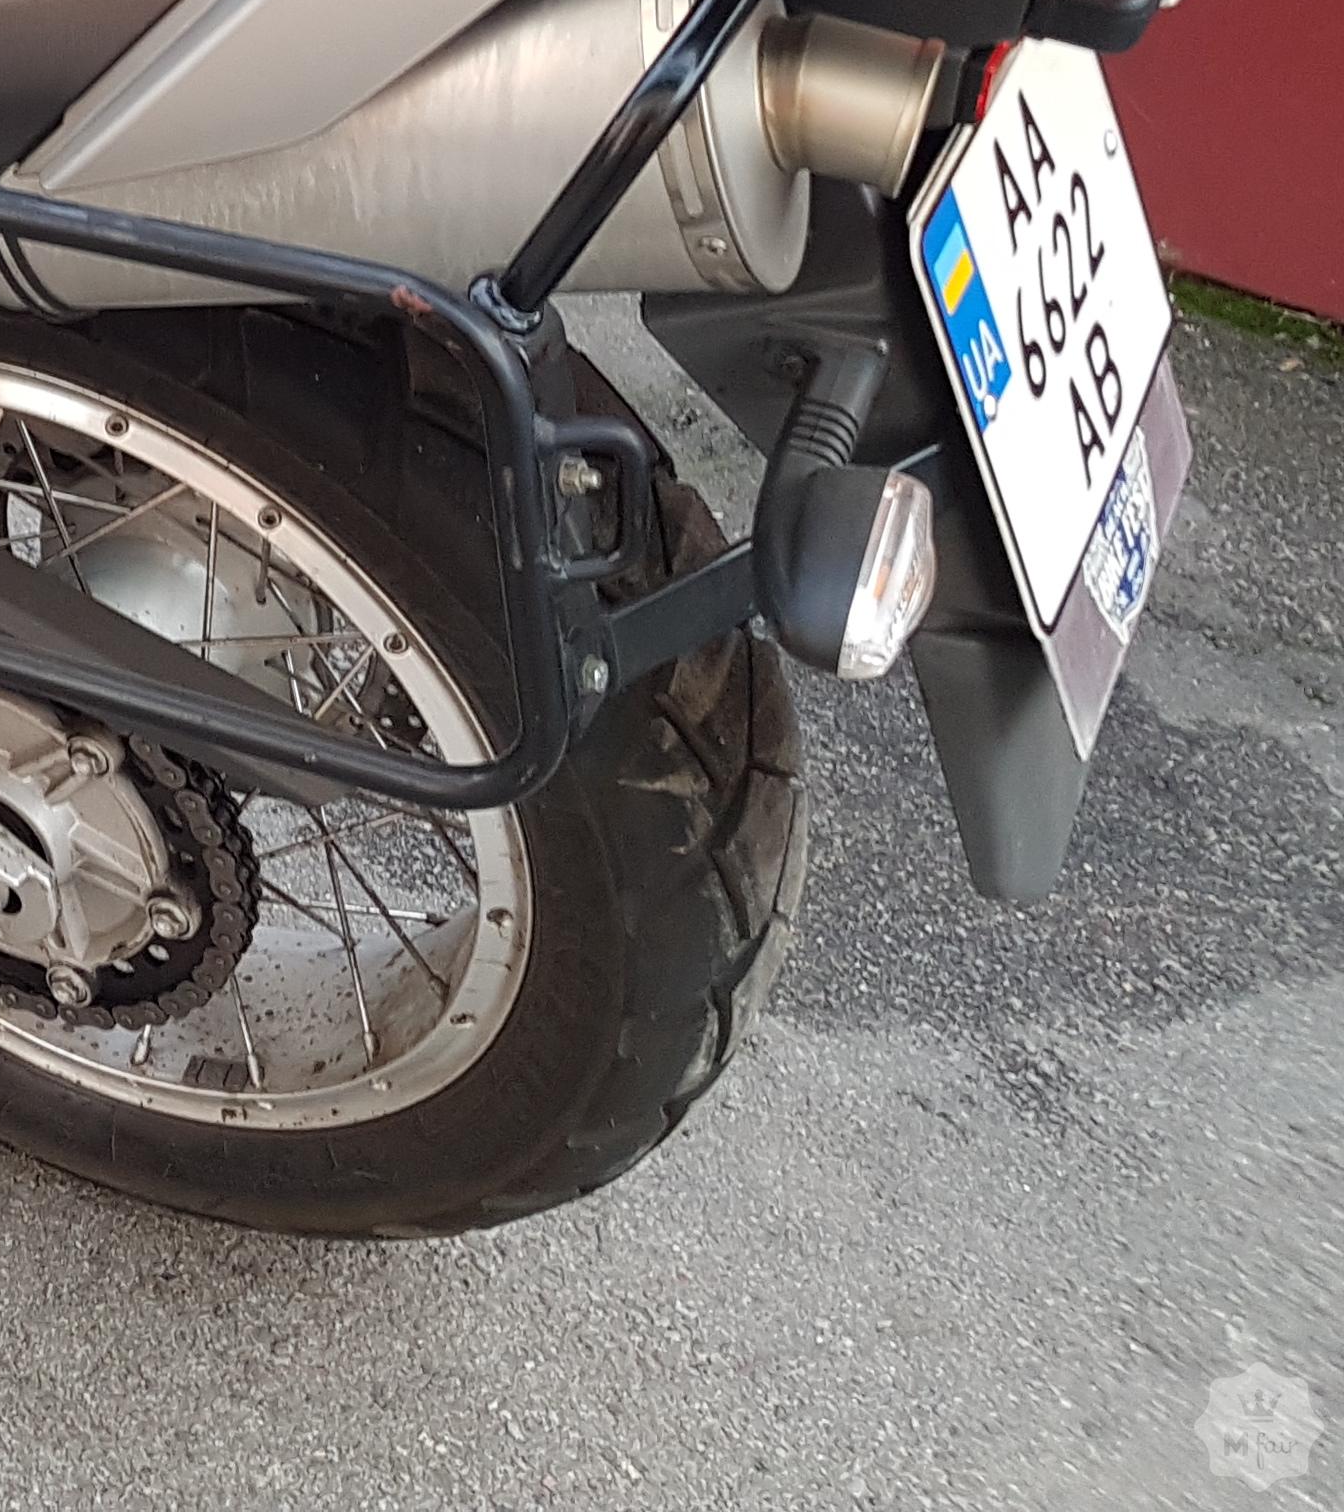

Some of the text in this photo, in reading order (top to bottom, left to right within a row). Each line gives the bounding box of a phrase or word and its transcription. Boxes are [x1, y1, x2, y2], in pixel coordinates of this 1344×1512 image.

[994, 88, 1055, 256] AA
[963, 319, 1004, 401] UA
[1017, 170, 1105, 400] 6622
[1070, 321, 1123, 490] AB
